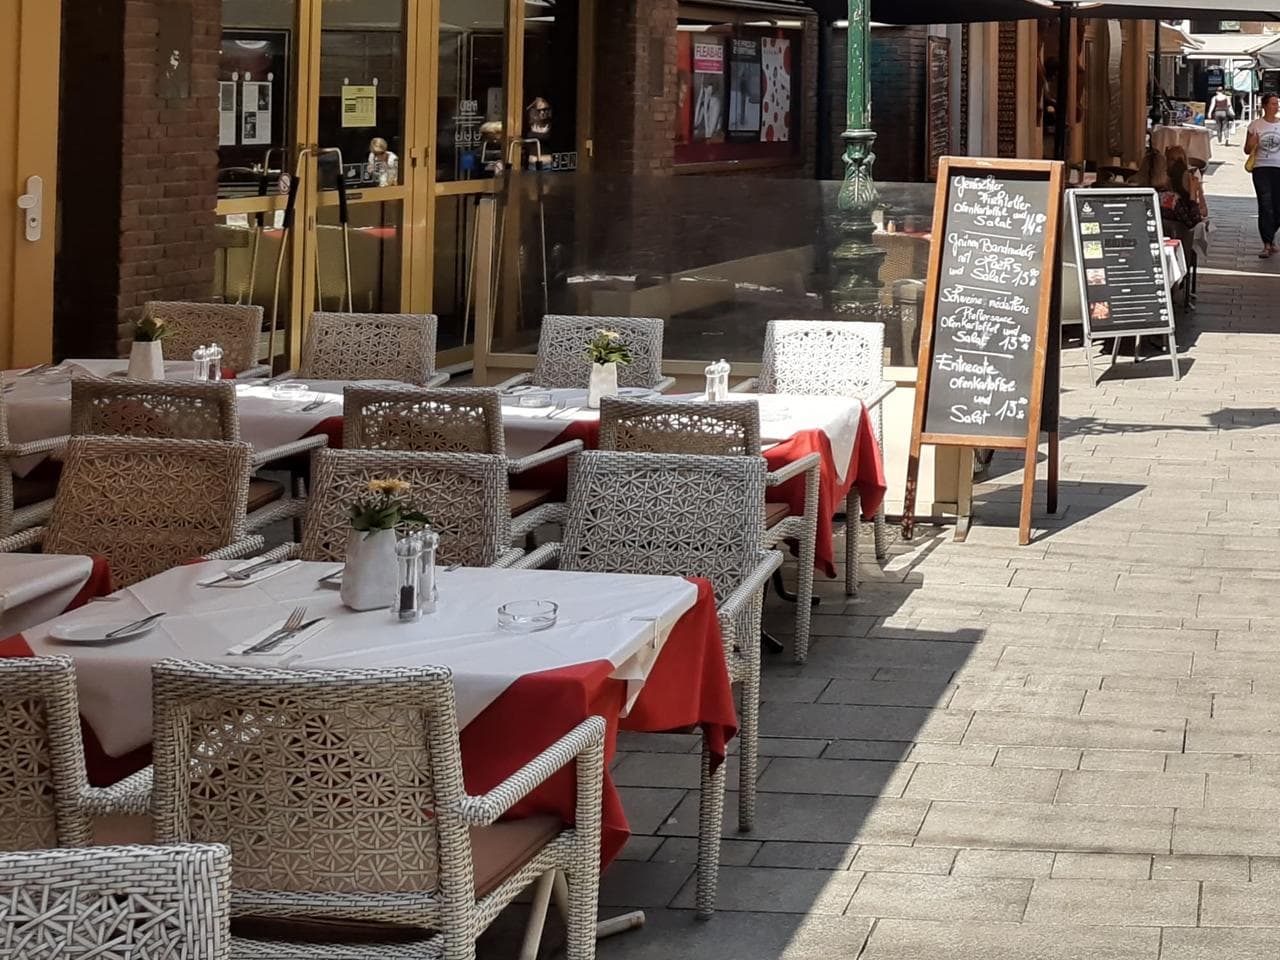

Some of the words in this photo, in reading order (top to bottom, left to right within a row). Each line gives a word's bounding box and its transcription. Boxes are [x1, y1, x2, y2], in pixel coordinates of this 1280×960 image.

[973, 215, 1012, 229] Salat
[975, 254, 1022, 273] Lachs
[970, 267, 1011, 283] Salat
[952, 330, 991, 348] Salat
[973, 391, 992, 405] und
[950, 404, 991, 425] Salat
